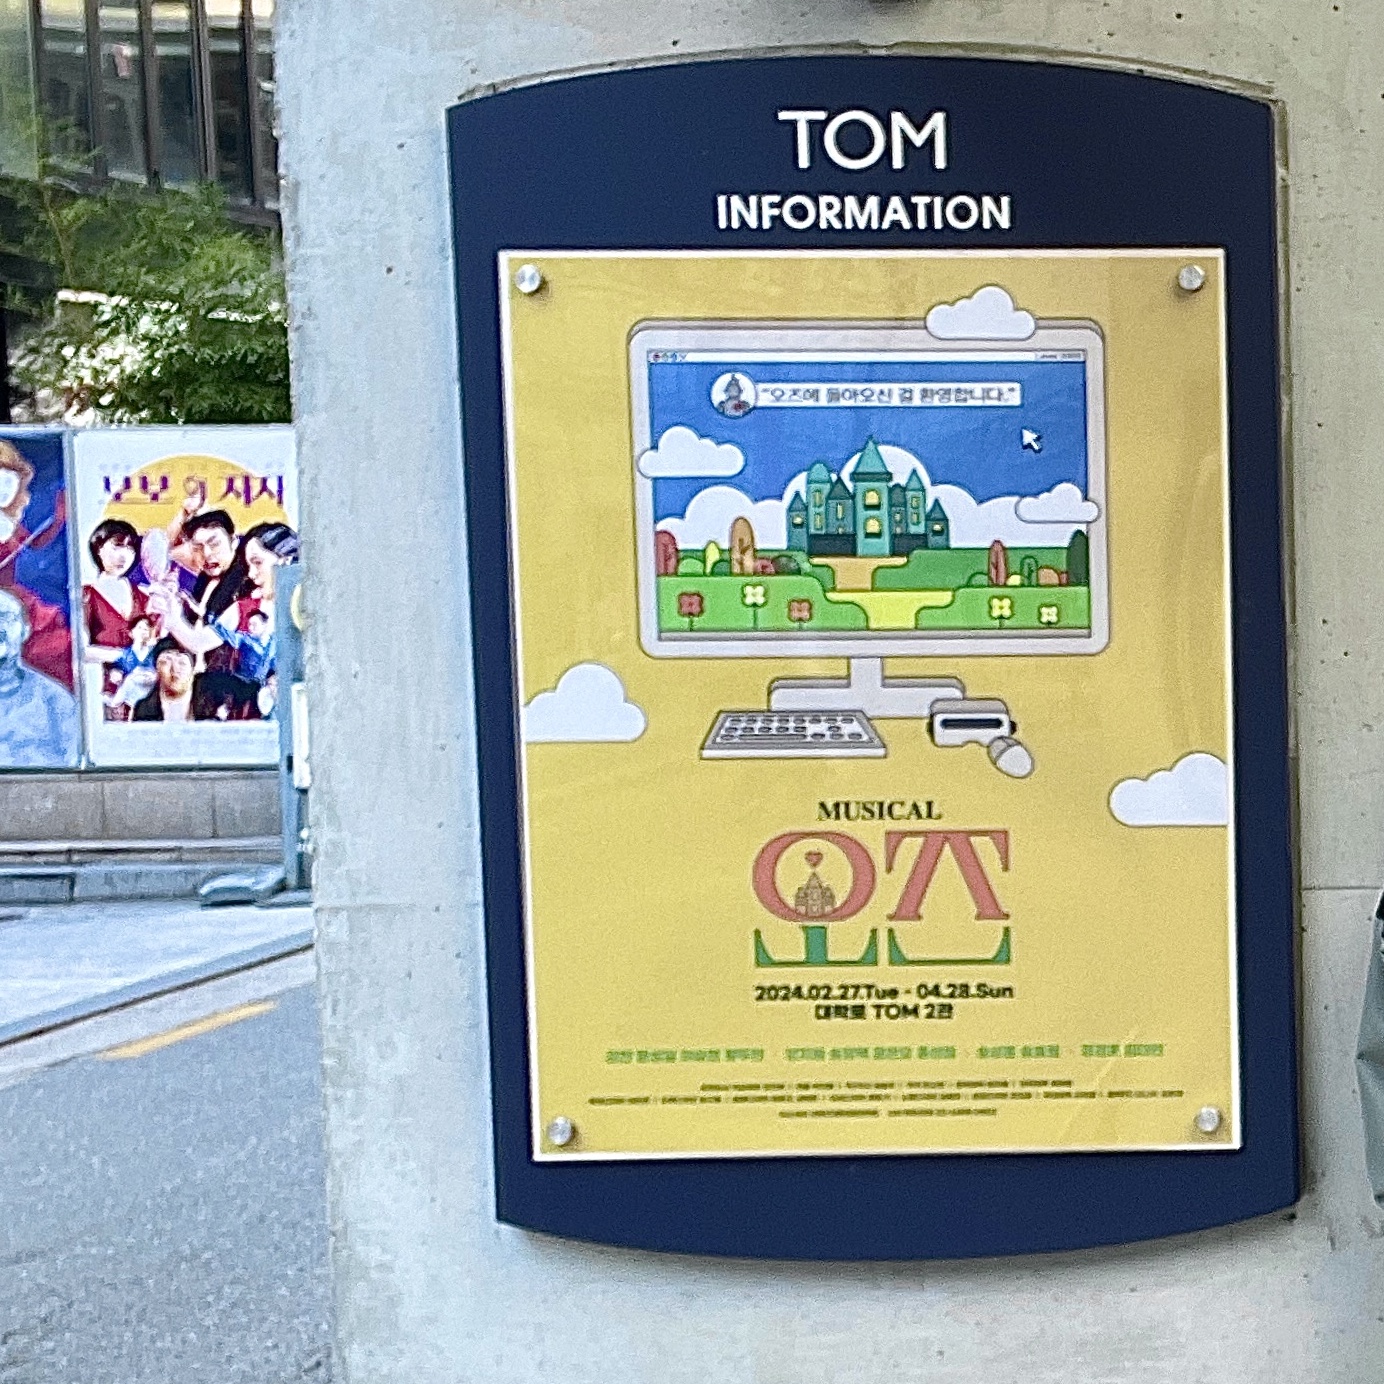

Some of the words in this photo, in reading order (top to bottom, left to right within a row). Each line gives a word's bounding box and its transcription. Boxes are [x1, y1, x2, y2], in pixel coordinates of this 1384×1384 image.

[777, 110, 948, 169] TOM
[717, 195, 1011, 229] INFORMATION
[818, 800, 943, 821] MUSICAL
[871, 1003, 920, 1020] TOM
